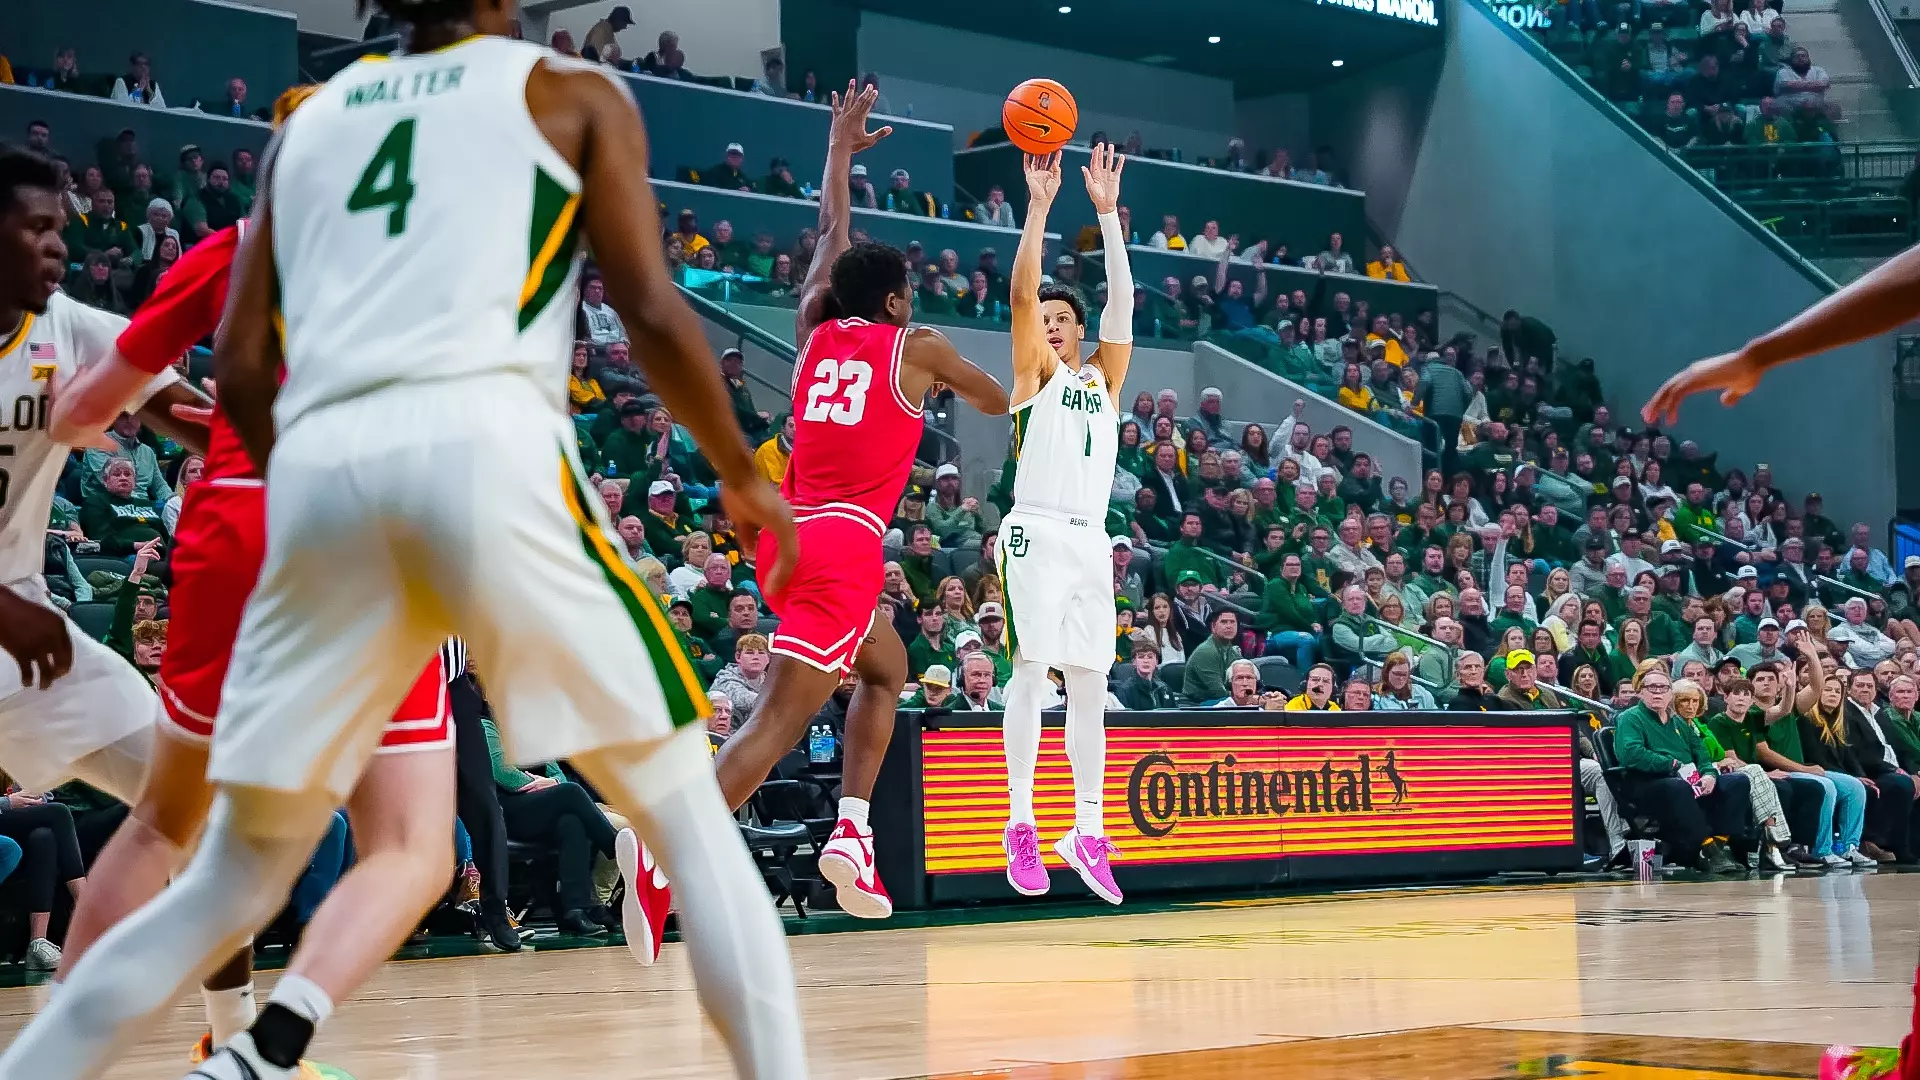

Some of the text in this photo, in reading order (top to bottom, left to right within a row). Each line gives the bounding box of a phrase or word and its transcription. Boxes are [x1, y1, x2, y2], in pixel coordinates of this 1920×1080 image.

[344, 65, 464, 107] WALTER
[346, 119, 415, 236] 4
[803, 358, 873, 426] 23
[1085, 420, 1092, 456] 1
[1127, 752, 1374, 838] Continental
